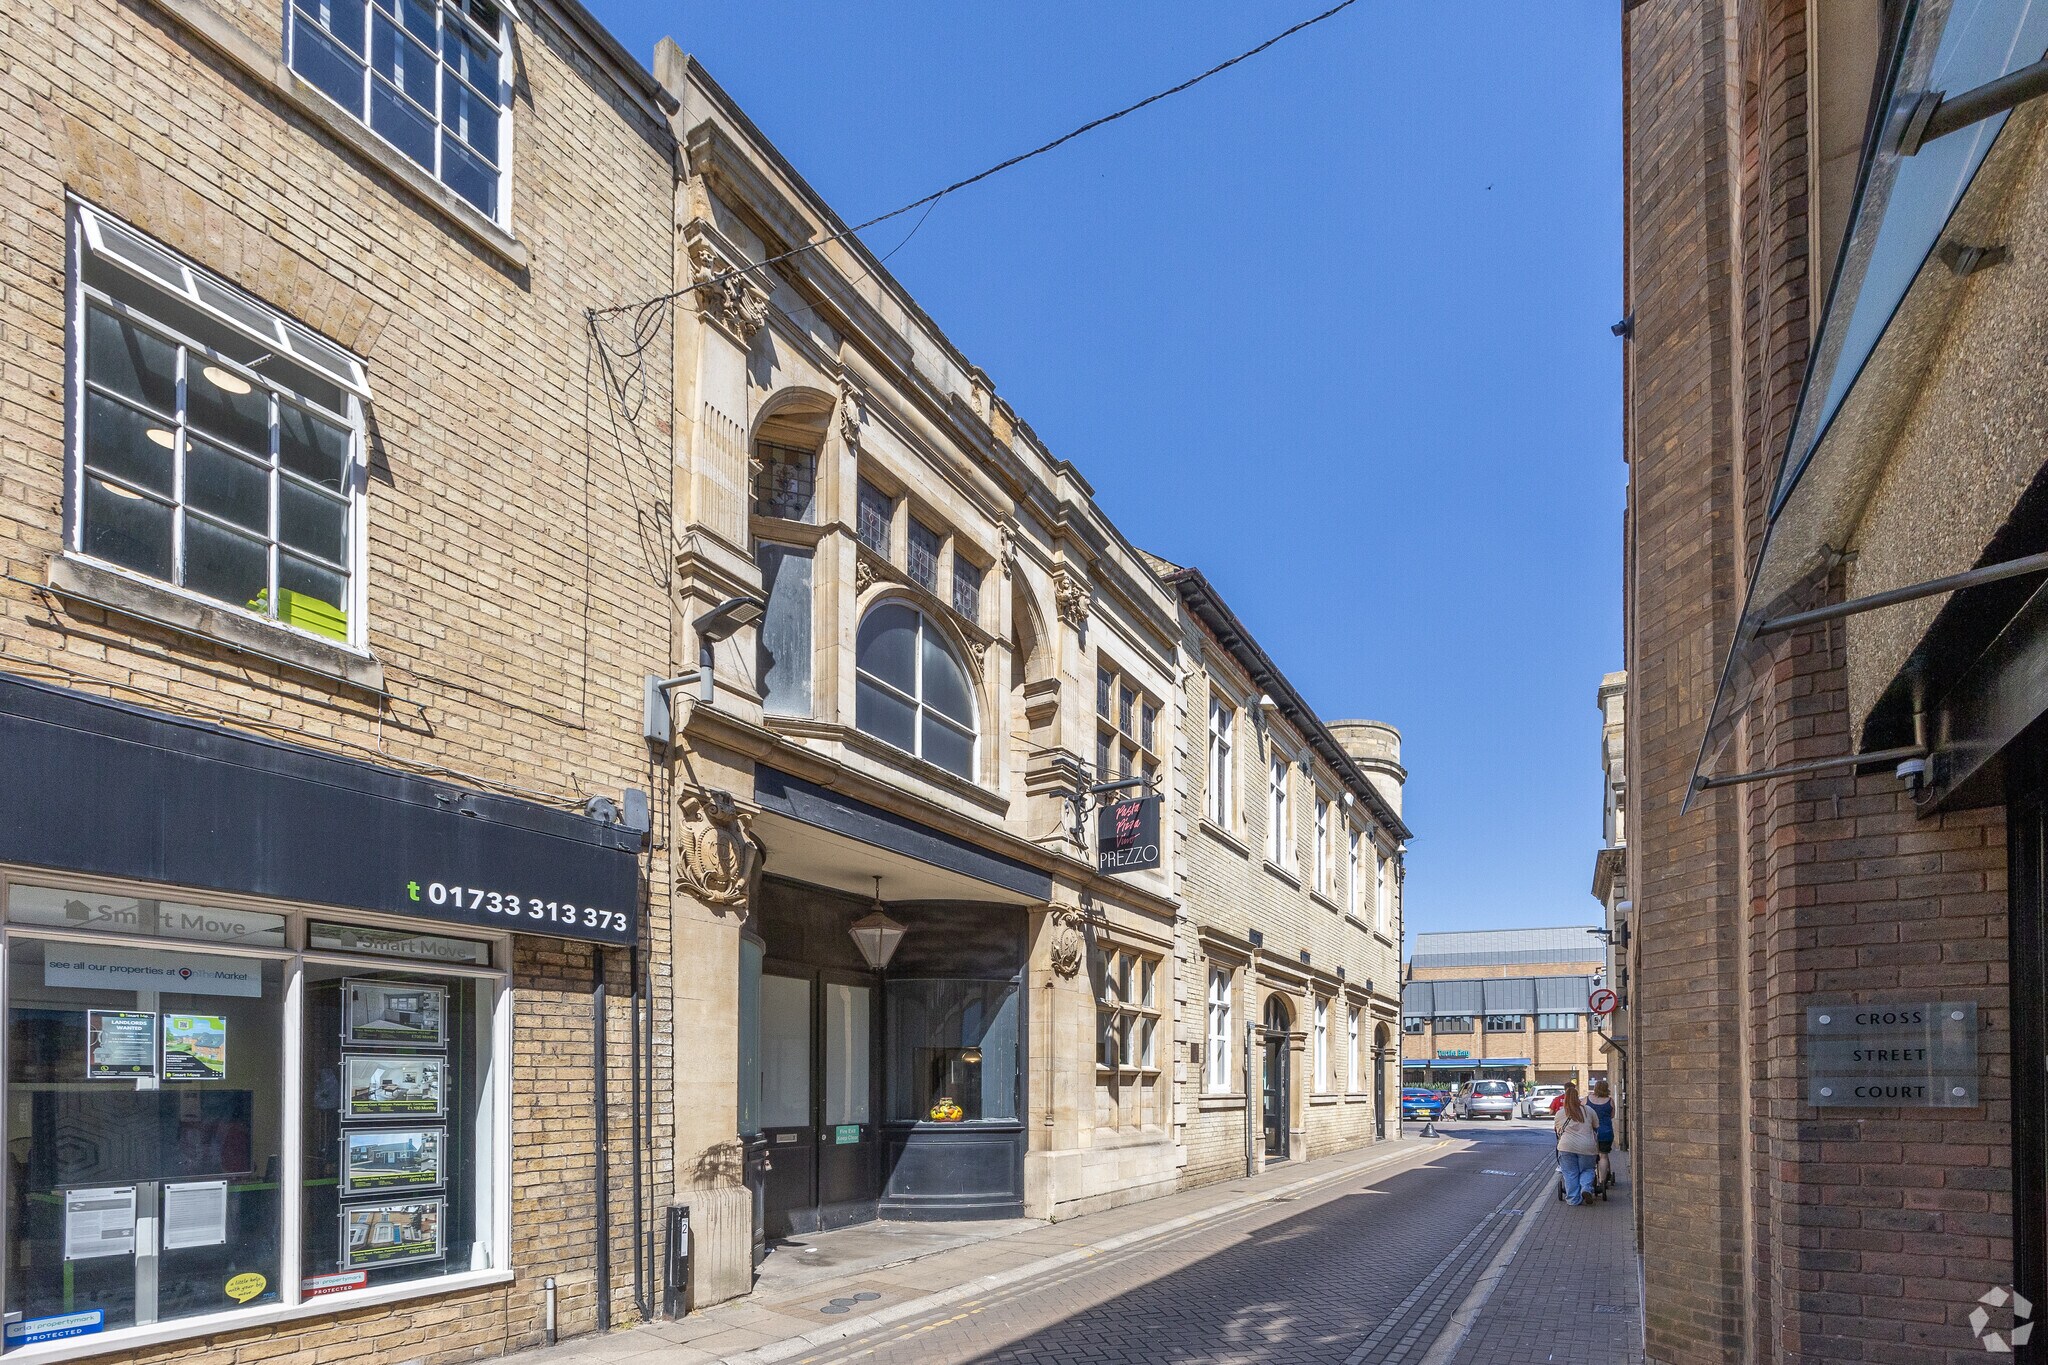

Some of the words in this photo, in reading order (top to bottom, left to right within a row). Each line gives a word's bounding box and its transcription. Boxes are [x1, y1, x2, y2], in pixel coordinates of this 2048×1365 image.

[1100, 844, 1158, 869] PREZZO
[407, 881, 420, 901] t
[428, 882, 520, 916] 01733
[528, 898, 576, 924] 313
[583, 907, 627, 932] 373
[98, 904, 173, 928] Smt
[181, 913, 245, 935] Move
[362, 934, 415, 953] Smart
[420, 940, 466, 958] Move
[49, 961, 70, 969] see
[73, 962, 85, 970] all
[88, 963, 106, 971] our
[109, 964, 163, 975] properties
[166, 967, 175, 976] at
[1855, 1011, 1922, 1025] CROSS
[1853, 1049, 1926, 1062] STREET
[1854, 1086, 1926, 1099] COURT
[682, 1223, 688, 1234] 2
[314, 1285, 353, 1295] PROTECTED
[13, 1324, 31, 1333] arla
[37, 1315, 95, 1329] propertymark
[26, 1328, 82, 1342] PROTECTED
